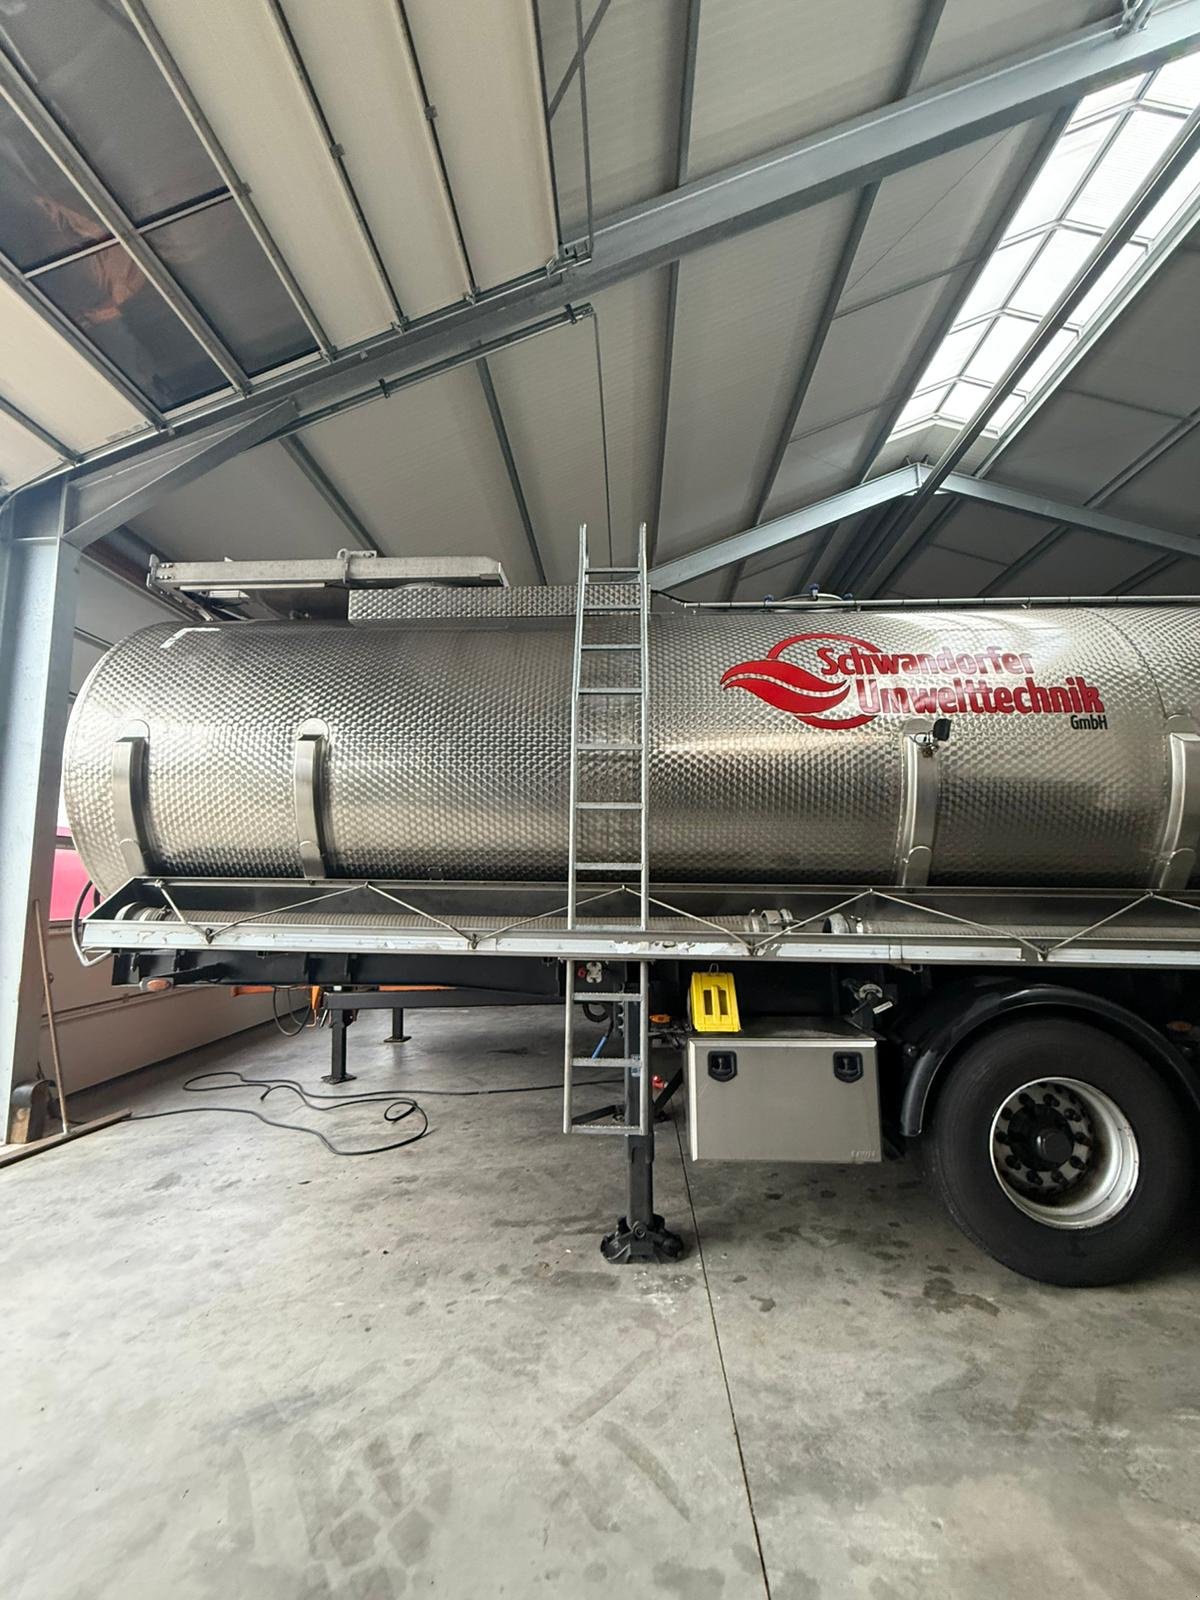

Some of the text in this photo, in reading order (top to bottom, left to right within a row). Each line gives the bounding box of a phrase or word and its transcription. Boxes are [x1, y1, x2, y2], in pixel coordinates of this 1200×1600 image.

[817, 646, 1036, 675] Schwandorfer
[856, 676, 1105, 714] Umwelttechnik
[1071, 715, 1108, 731] GmbH
